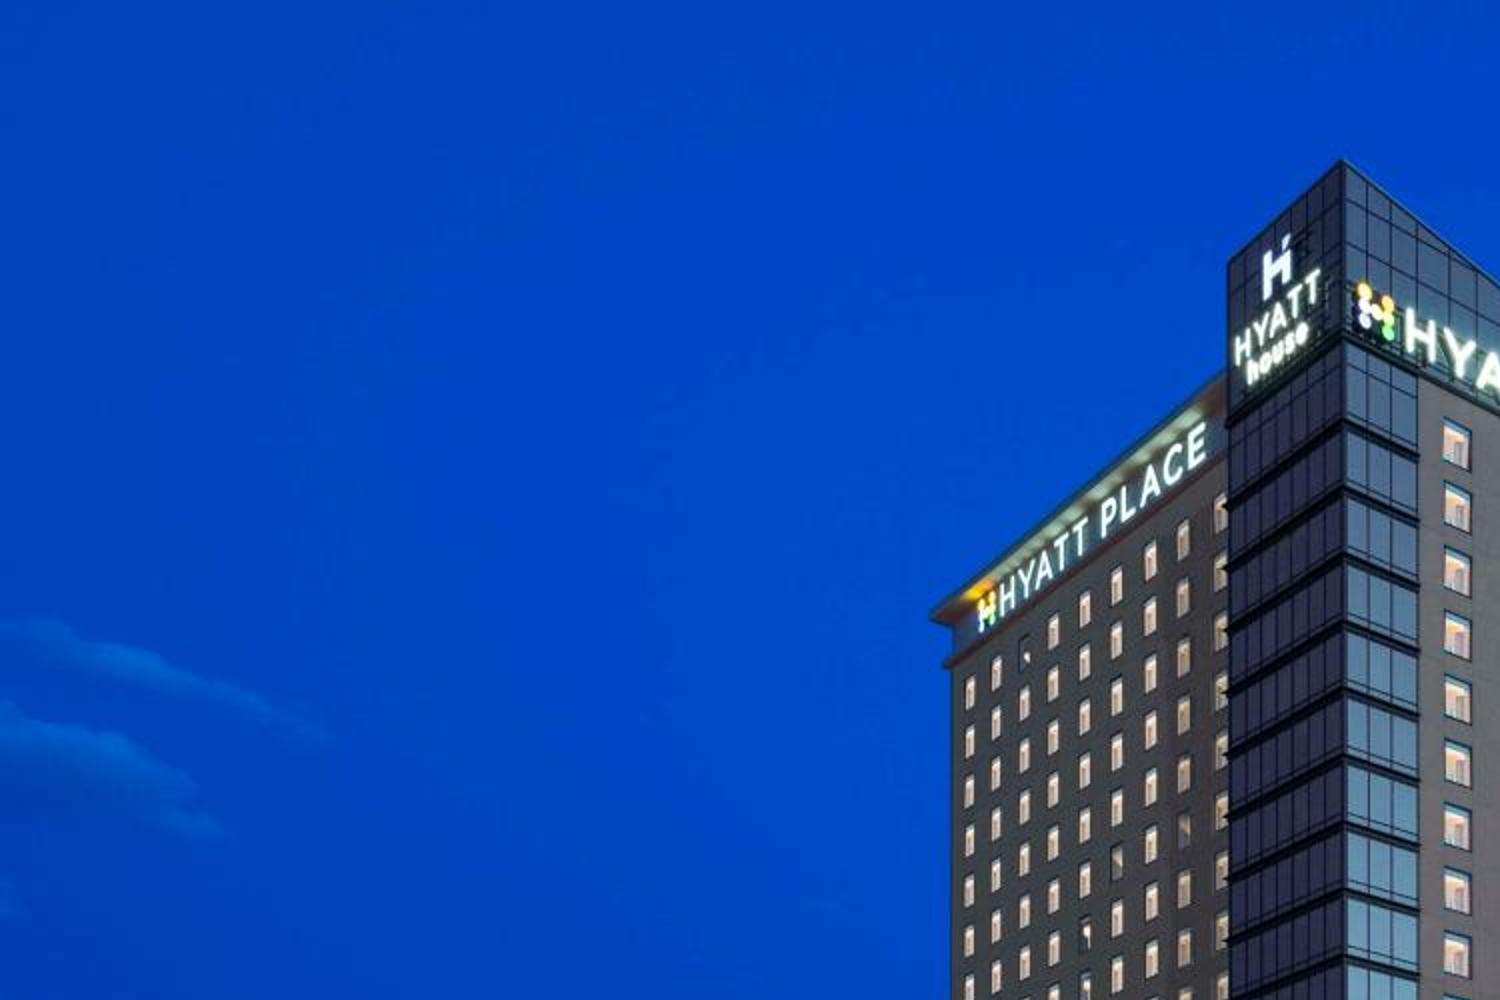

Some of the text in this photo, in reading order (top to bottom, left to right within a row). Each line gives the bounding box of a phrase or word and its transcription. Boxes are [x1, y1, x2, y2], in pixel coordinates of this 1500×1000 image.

[1234, 268, 1321, 367] HYATT
[1246, 322, 1310, 386] house
[999, 517, 1089, 617] HYATT
[1100, 421, 1207, 539] PLACE
